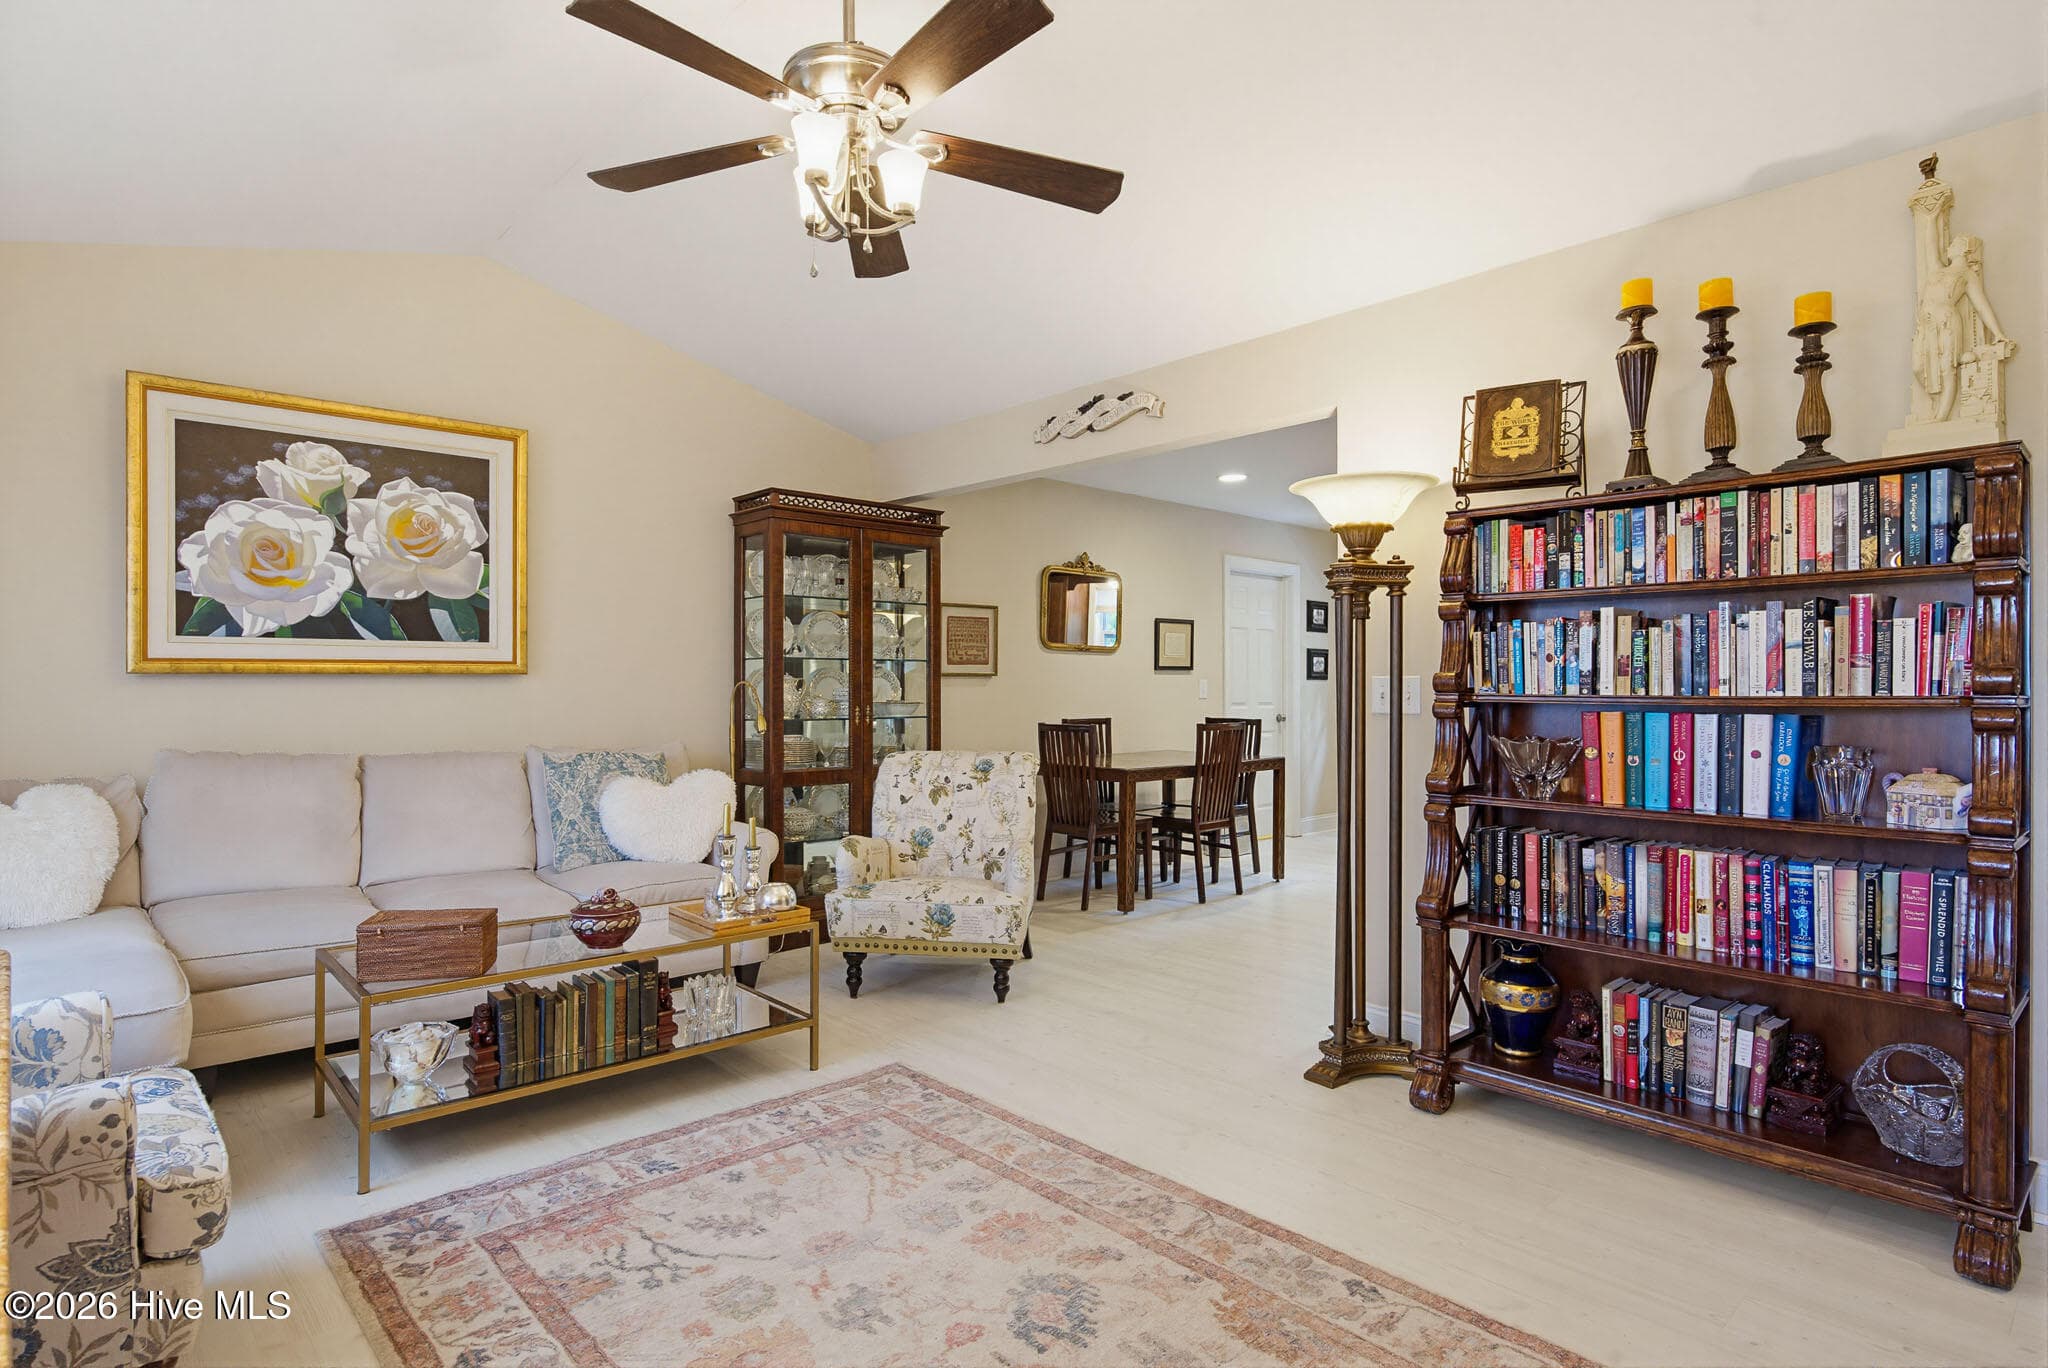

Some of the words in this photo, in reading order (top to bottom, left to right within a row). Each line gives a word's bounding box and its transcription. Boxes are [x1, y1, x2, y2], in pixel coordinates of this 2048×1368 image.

[1803, 600, 1814, 620] V.E.
[1634, 637, 1644, 667] WICKED
[1803, 622, 1814, 668] SCHWAB
[1763, 864, 1772, 914] CLANLANDS
[1749, 907, 1758, 936] Elephants
[1937, 897, 1947, 938] SPLENDID
[1936, 956, 1945, 973] VILE
[1664, 1017, 1684, 1030] RAND
[1666, 1008, 1683, 1019] AYN
[1663, 1046, 1674, 1083] SHRUGGED
[1673, 1047, 1685, 1070] ATLAS
